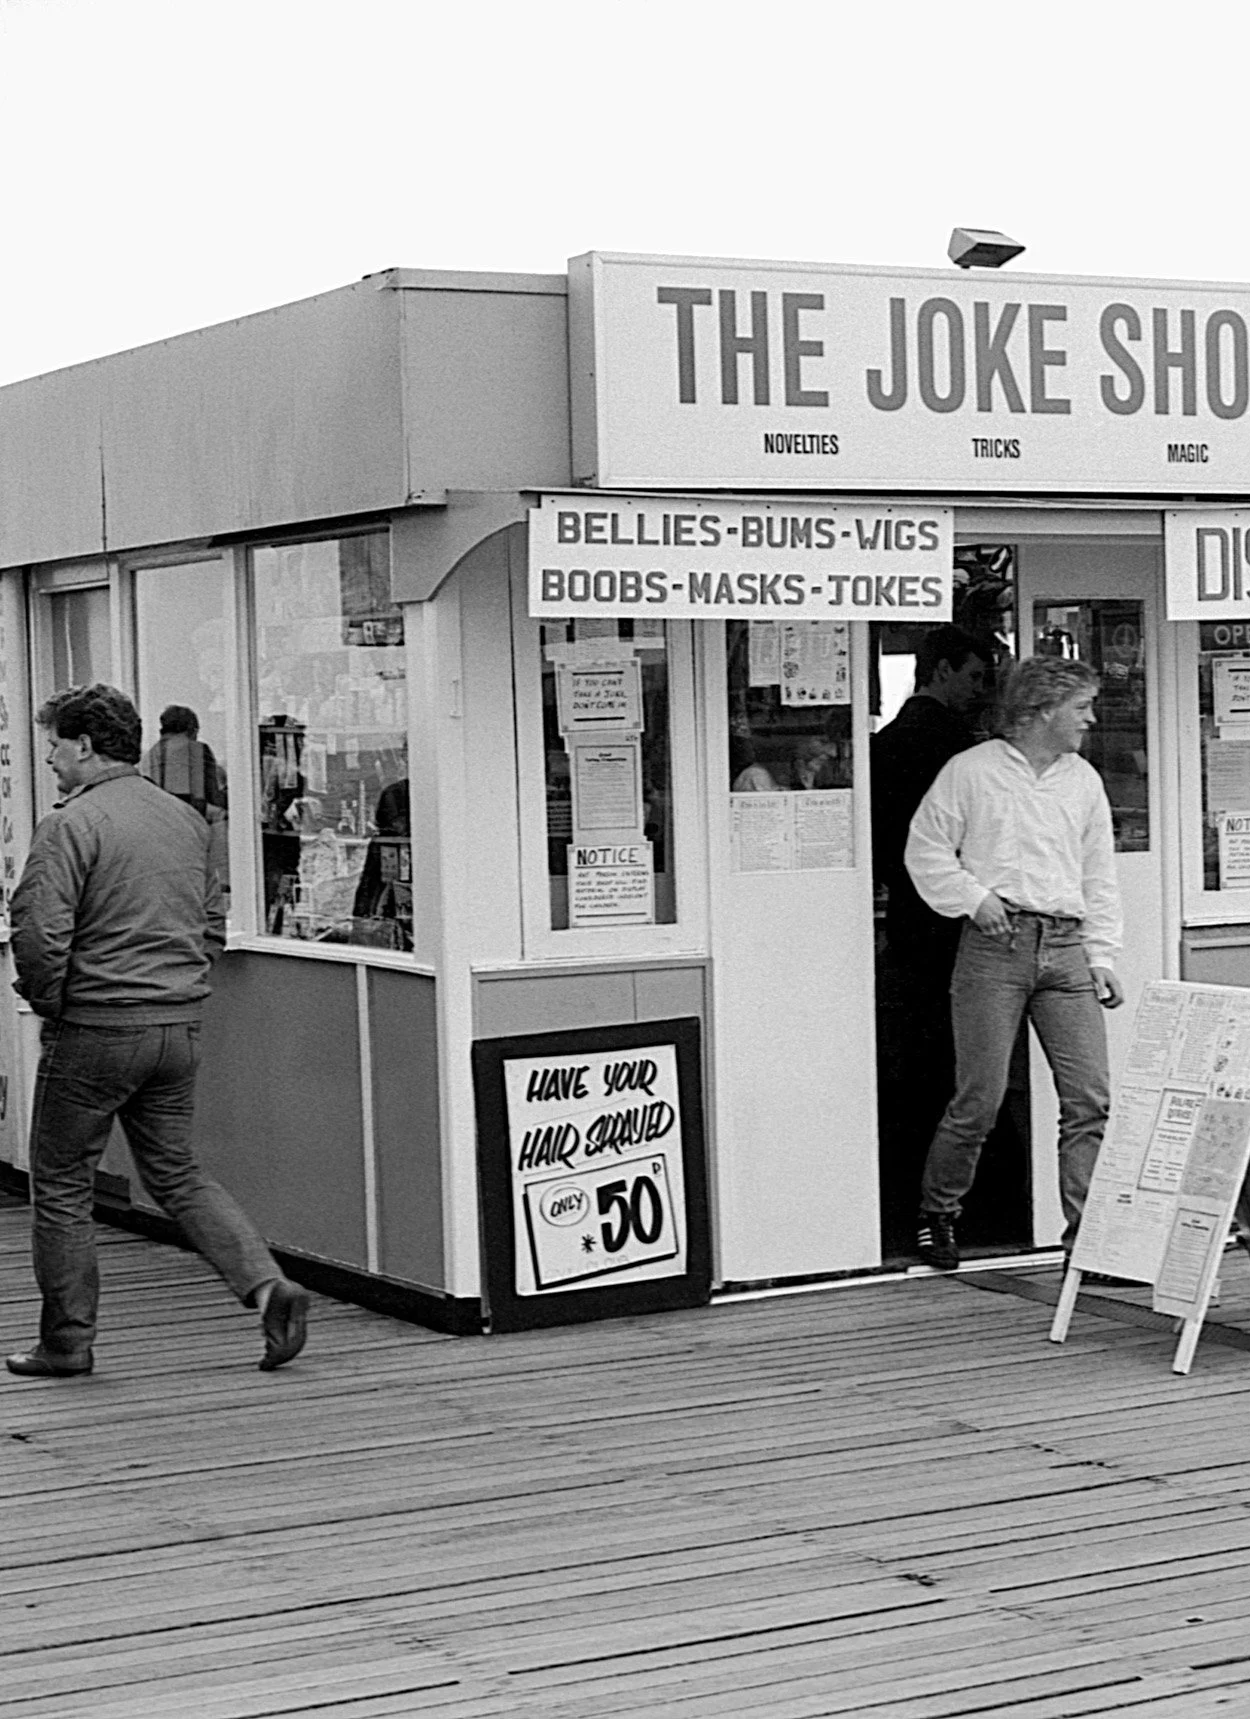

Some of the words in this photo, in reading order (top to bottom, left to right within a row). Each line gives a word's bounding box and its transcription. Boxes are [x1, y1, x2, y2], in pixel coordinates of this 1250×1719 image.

[657, 286, 830, 408] THE
[866, 297, 1072, 415] JOKE
[764, 433, 839, 455] NOVELTIES
[972, 438, 1021, 459] TRICKS
[1167, 443, 1209, 464] MAGIC
[577, 847, 639, 866] NOTICE
[526, 1066, 590, 1102] HAVE
[604, 1060, 658, 1096] YOUR
[518, 1123, 581, 1171] HAIR
[584, 1101, 675, 1155] SPRAYED
[550, 1193, 584, 1217] ONLY
[596, 1175, 664, 1254] 50
